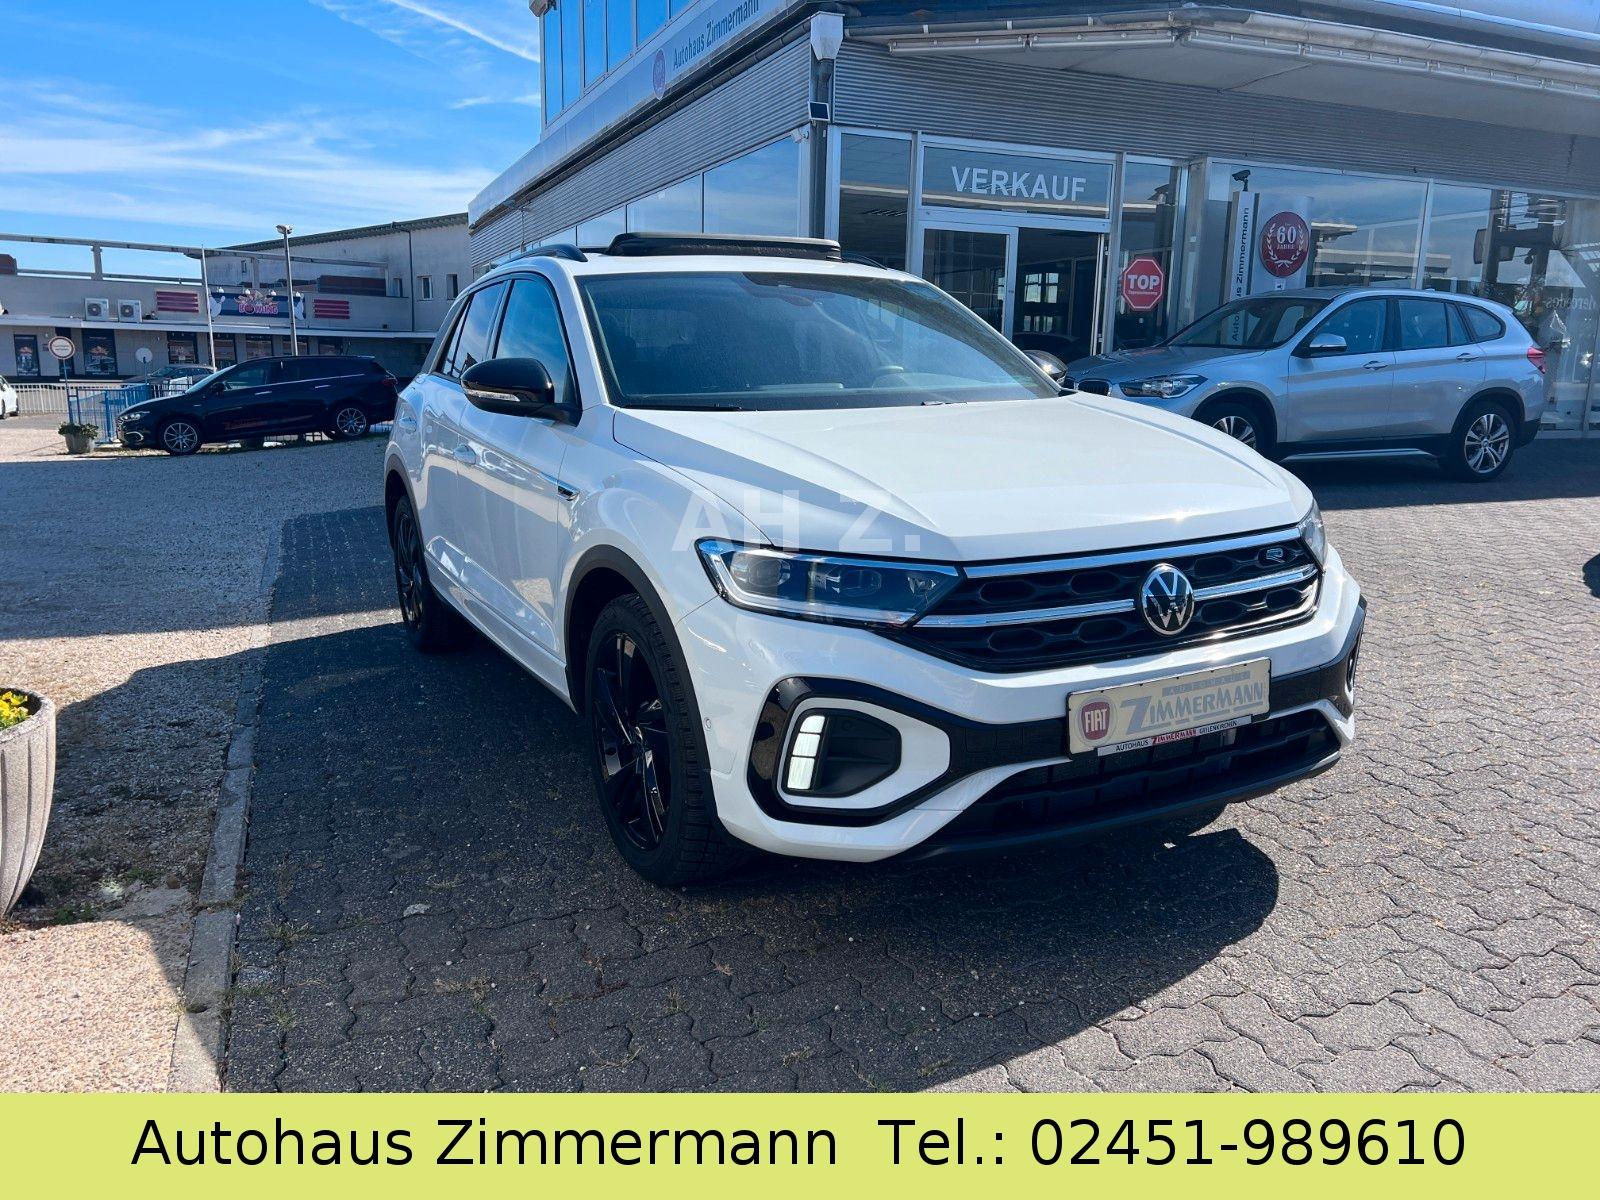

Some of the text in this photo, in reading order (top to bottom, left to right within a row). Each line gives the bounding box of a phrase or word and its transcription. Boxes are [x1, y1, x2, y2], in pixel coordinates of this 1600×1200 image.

[673, 0, 759, 70] Autohaus Zimmermann
[951, 166, 1087, 201] VERKAUF
[1236, 207, 1249, 283] Zimmermann
[1276, 226, 1297, 244] 60
[1127, 274, 1160, 290] TOP
[239, 303, 279, 315] BOWLING
[1084, 709, 1108, 733] FIAT
[1120, 682, 1263, 736] ZIMMERMANN
[1115, 739, 1149, 752] AUTOHAUS
[1152, 728, 1197, 745] ZIMMERMANN
